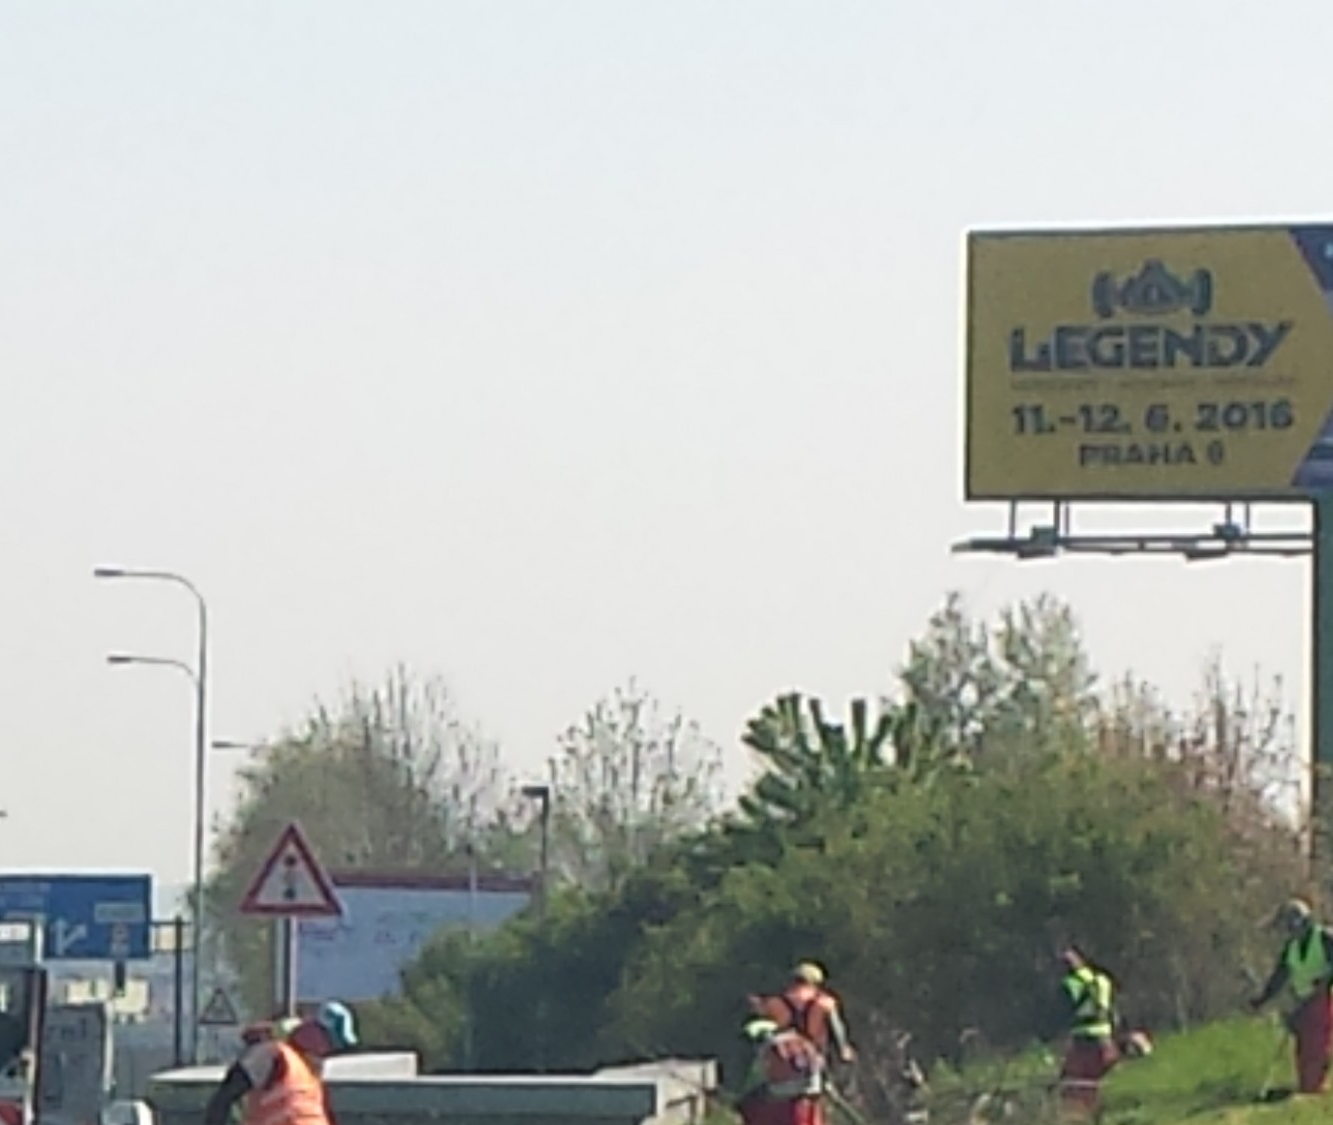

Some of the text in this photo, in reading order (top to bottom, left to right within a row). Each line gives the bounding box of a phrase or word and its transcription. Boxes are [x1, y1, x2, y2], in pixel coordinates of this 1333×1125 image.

[1009, 320, 1294, 372] LEGENDY
[1195, 399, 1294, 432] 2016
[1079, 442, 1197, 466] PRAHA
